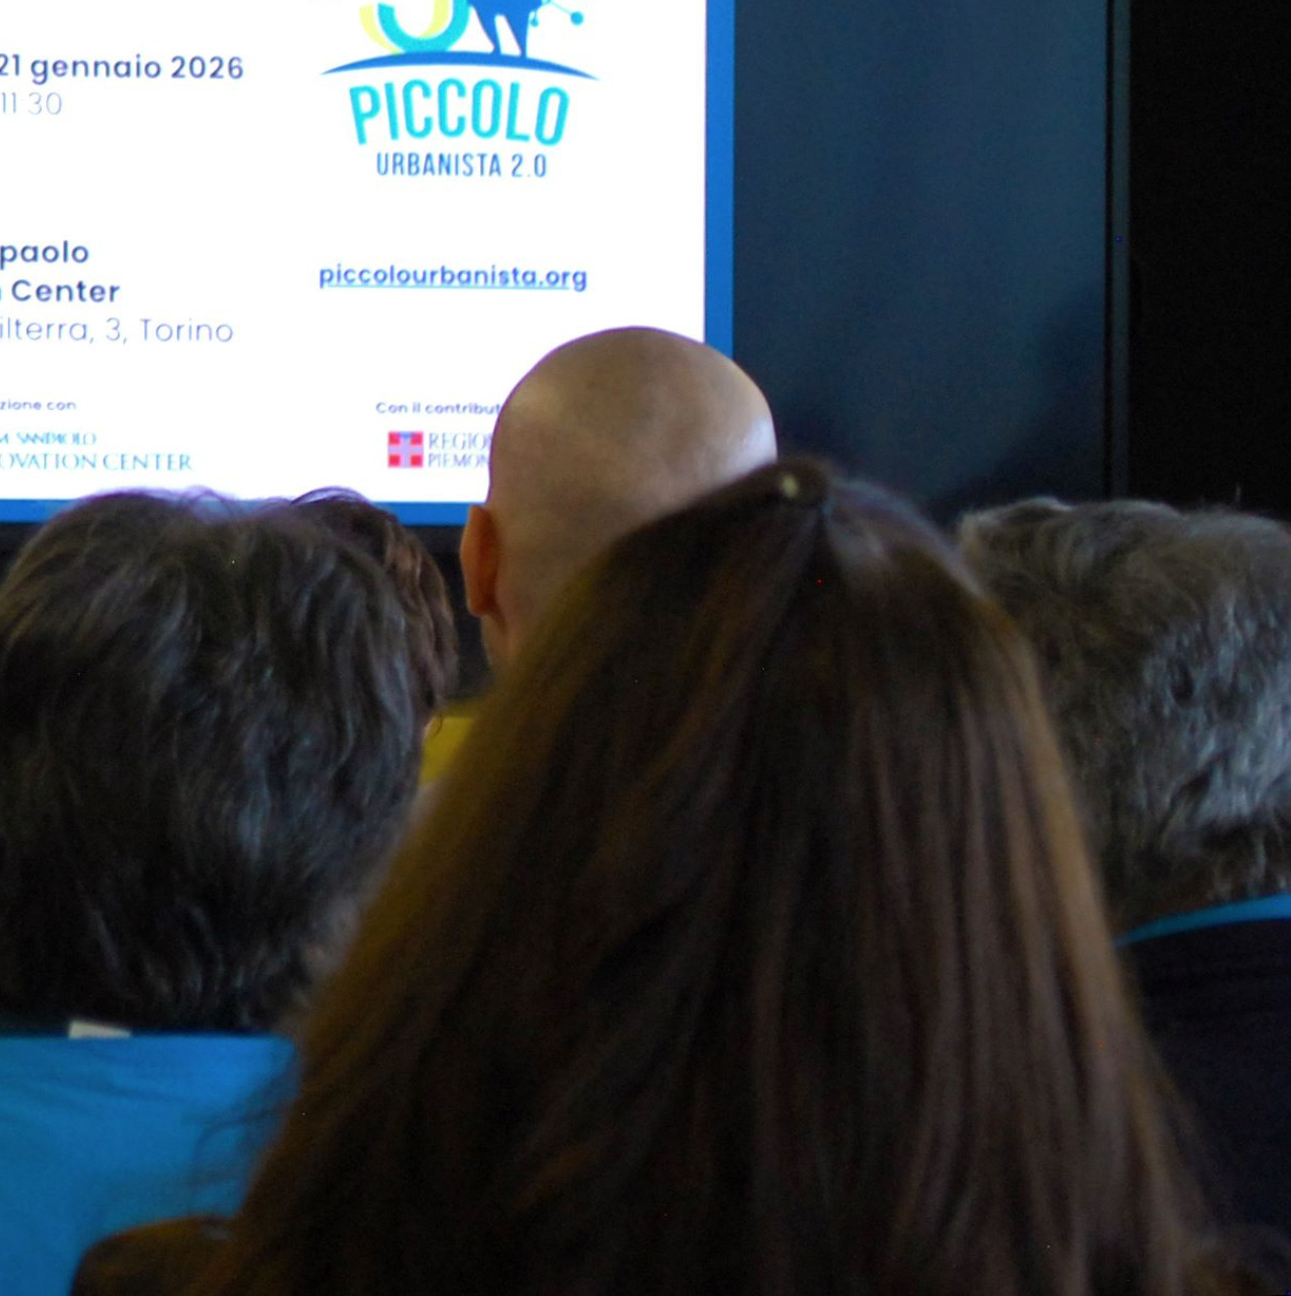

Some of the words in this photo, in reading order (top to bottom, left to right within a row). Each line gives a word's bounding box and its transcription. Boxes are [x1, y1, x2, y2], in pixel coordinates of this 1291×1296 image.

[30, 53, 162, 85] gennaio
[171, 55, 244, 79] 2026
[349, 78, 570, 147] PICCOLO
[376, 152, 502, 177] URBANISTA
[511, 153, 547, 178] 2.0
[10, 278, 121, 303] Center
[319, 263, 588, 292] piccolourbanista.org
[106, 317, 128, 344] 3,
[139, 317, 235, 343] Torino
[46, 400, 77, 411] con
[375, 402, 409, 414] Con
[412, 402, 421, 413] il
[102, 452, 193, 472] CENTER
